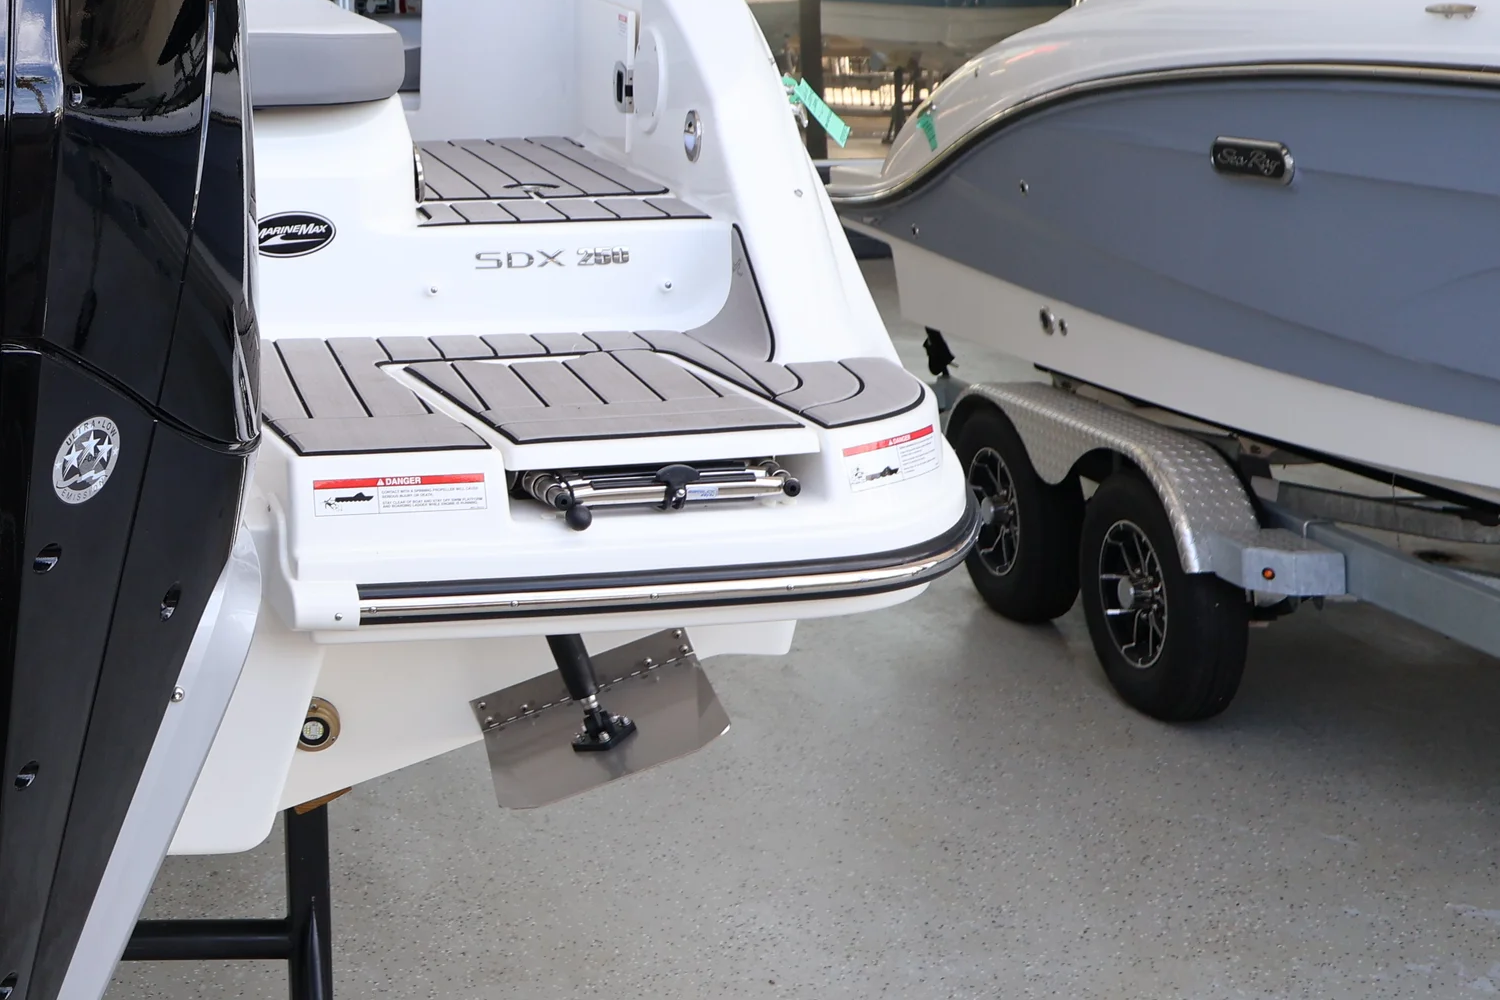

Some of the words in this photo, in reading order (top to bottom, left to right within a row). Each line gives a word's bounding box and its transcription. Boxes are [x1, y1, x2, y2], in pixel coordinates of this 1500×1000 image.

[1217, 148, 1248, 167] Sea
[475, 249, 566, 270] SDX
[576, 245, 630, 267] 250
[65, 419, 97, 446] ULTRA
[101, 419, 117, 437] LOW
[385, 477, 422, 486] DANGER
